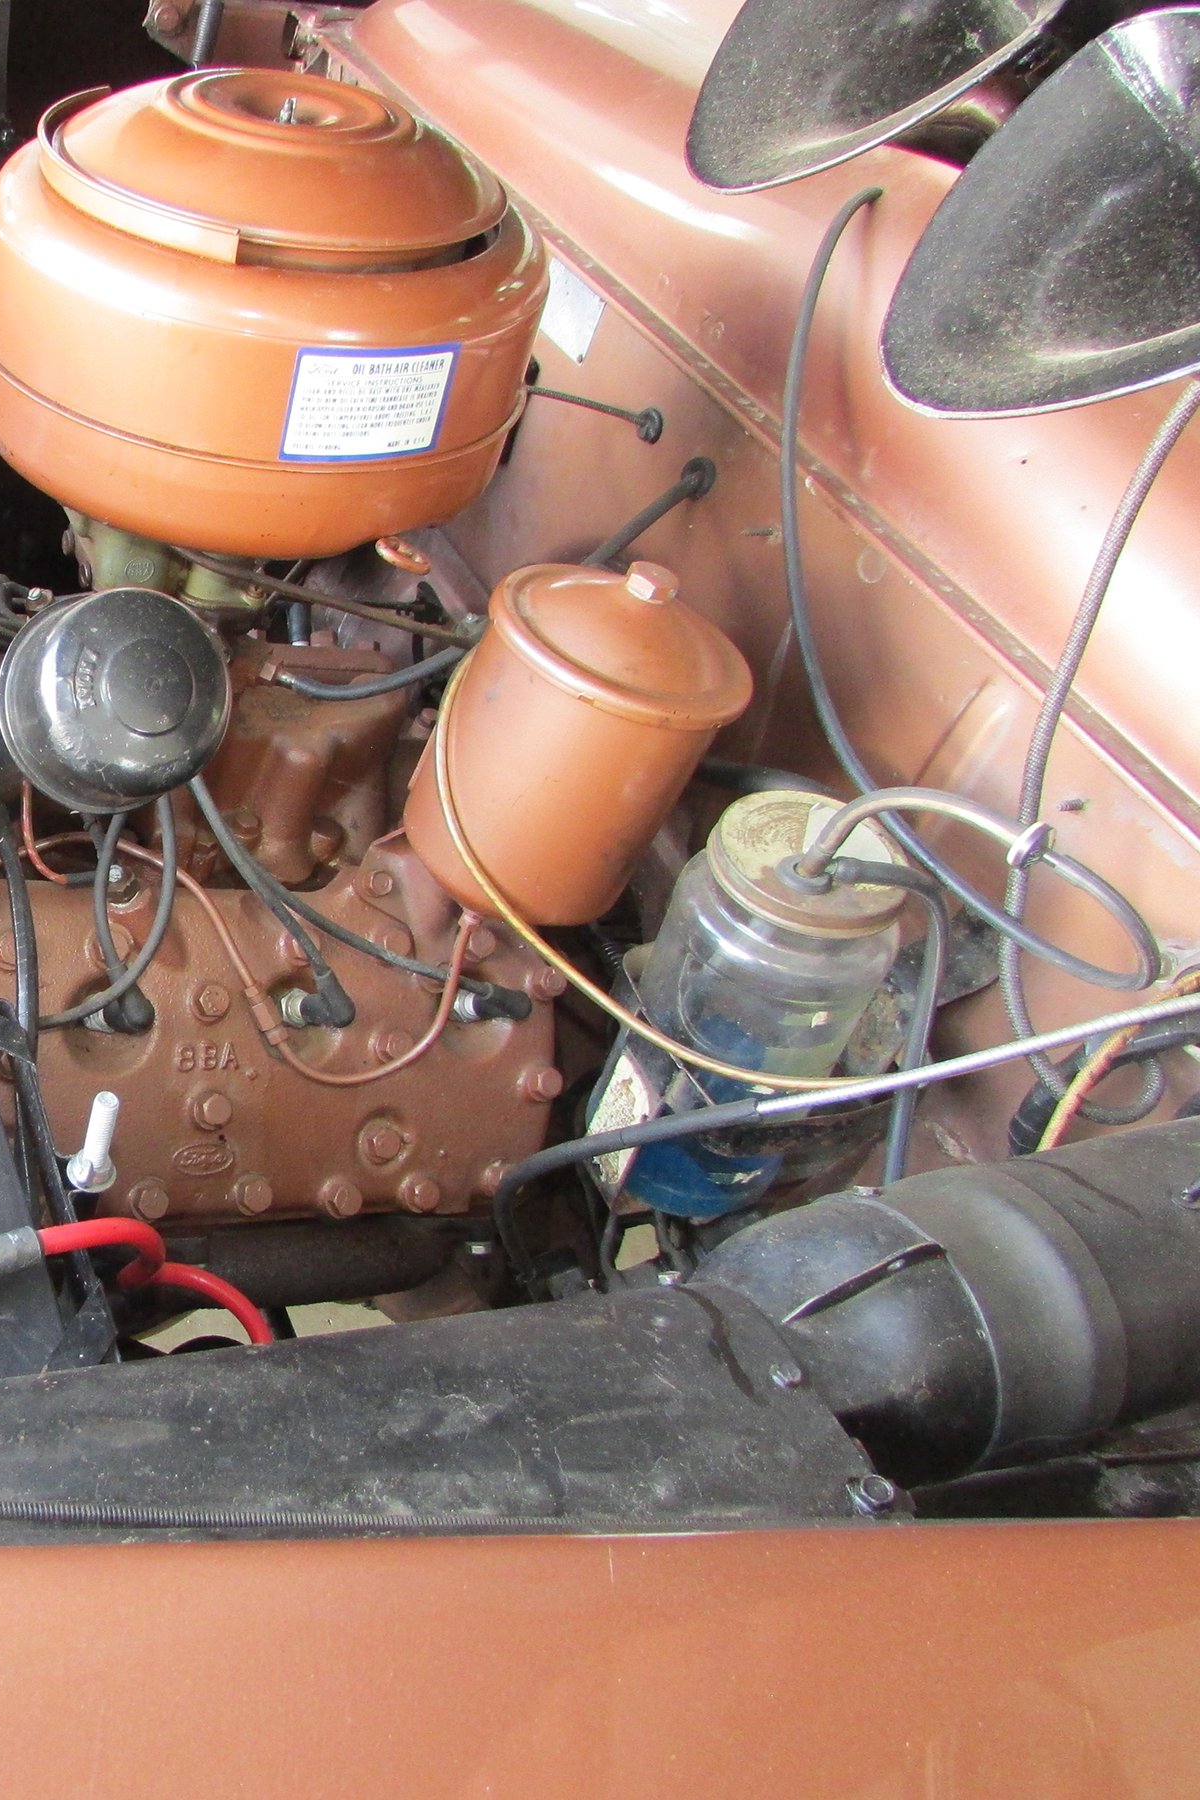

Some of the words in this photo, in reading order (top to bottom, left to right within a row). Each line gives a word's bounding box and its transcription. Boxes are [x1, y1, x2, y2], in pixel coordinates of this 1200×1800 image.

[352, 363, 366, 376] OIL
[369, 363, 393, 375] BATH
[394, 362, 410, 374] AIR
[411, 359, 445, 373] CLEANER
[327, 379, 361, 387] SERVICE
[365, 376, 424, 386] INSTRUCTIONS
